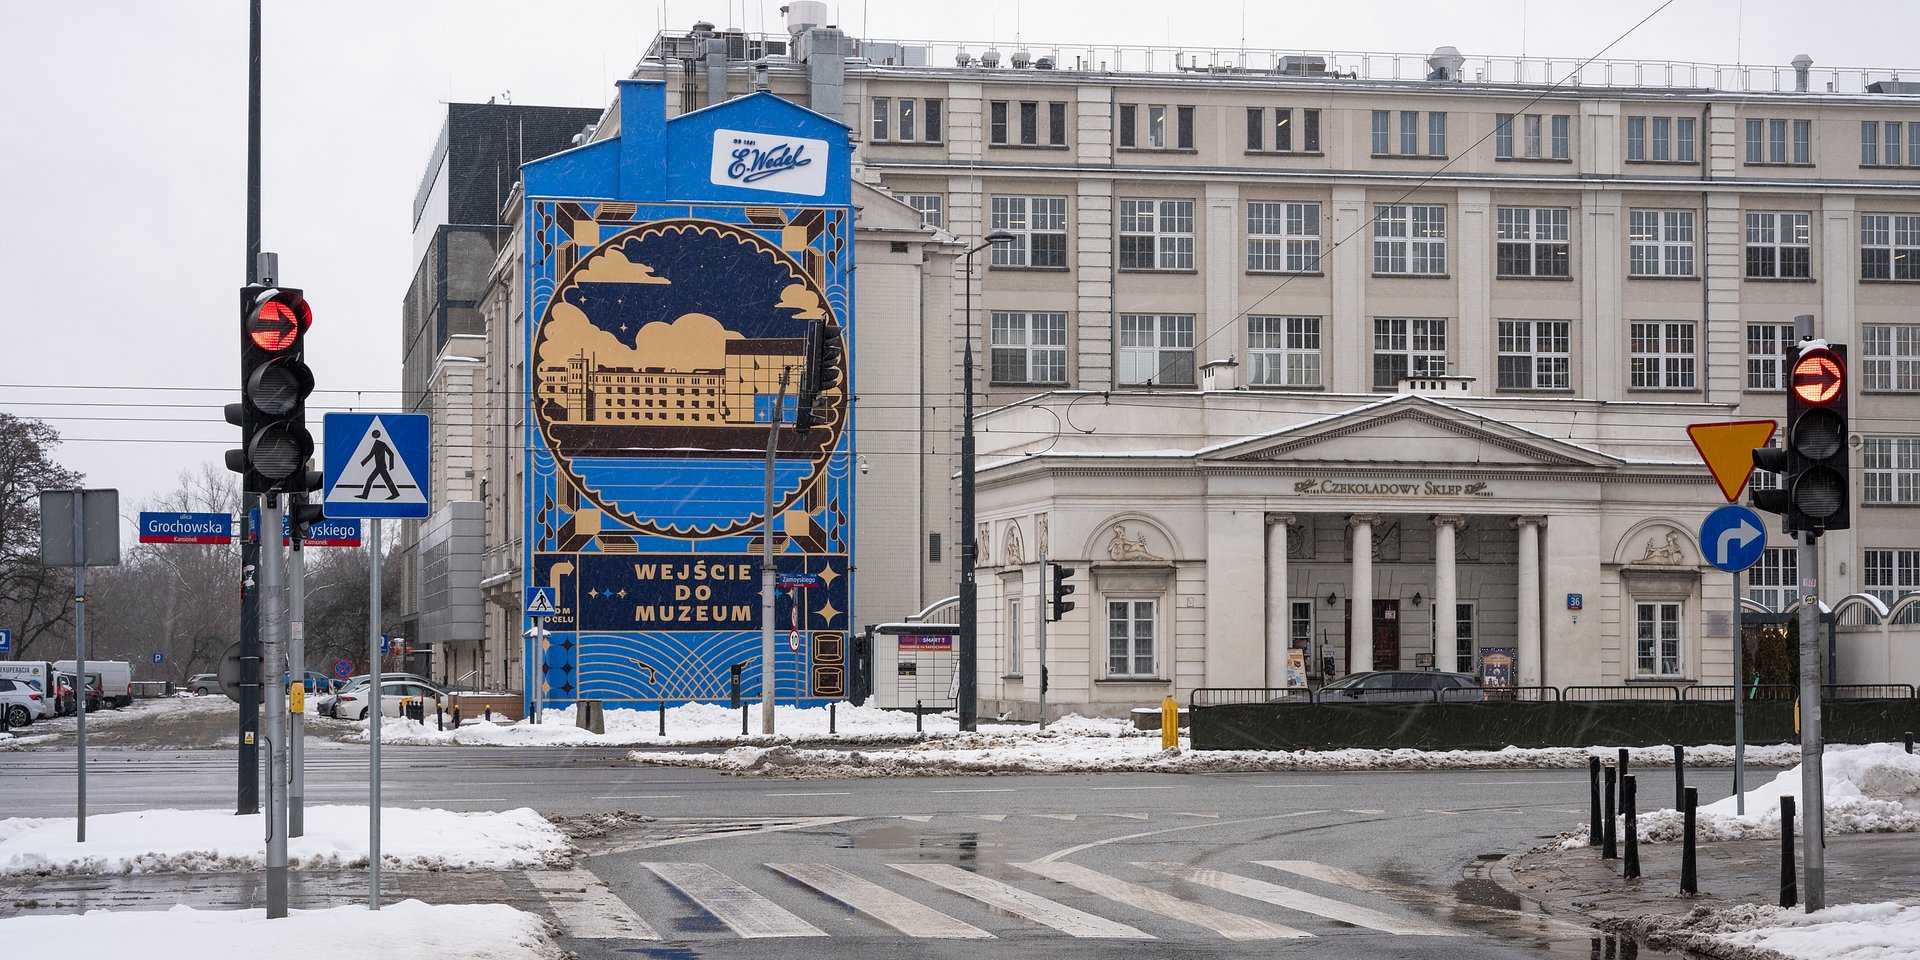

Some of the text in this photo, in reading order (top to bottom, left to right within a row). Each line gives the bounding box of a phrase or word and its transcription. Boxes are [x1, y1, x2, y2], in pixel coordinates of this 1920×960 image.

[1321, 479, 1462, 496] CZEKOLADOWY SKLEP
[149, 520, 222, 533] Grochowska
[634, 560, 752, 580] WEJŚCIE
[675, 585, 712, 601] DO
[1570, 597, 1580, 606] 36
[635, 605, 752, 622] MUZEUM
